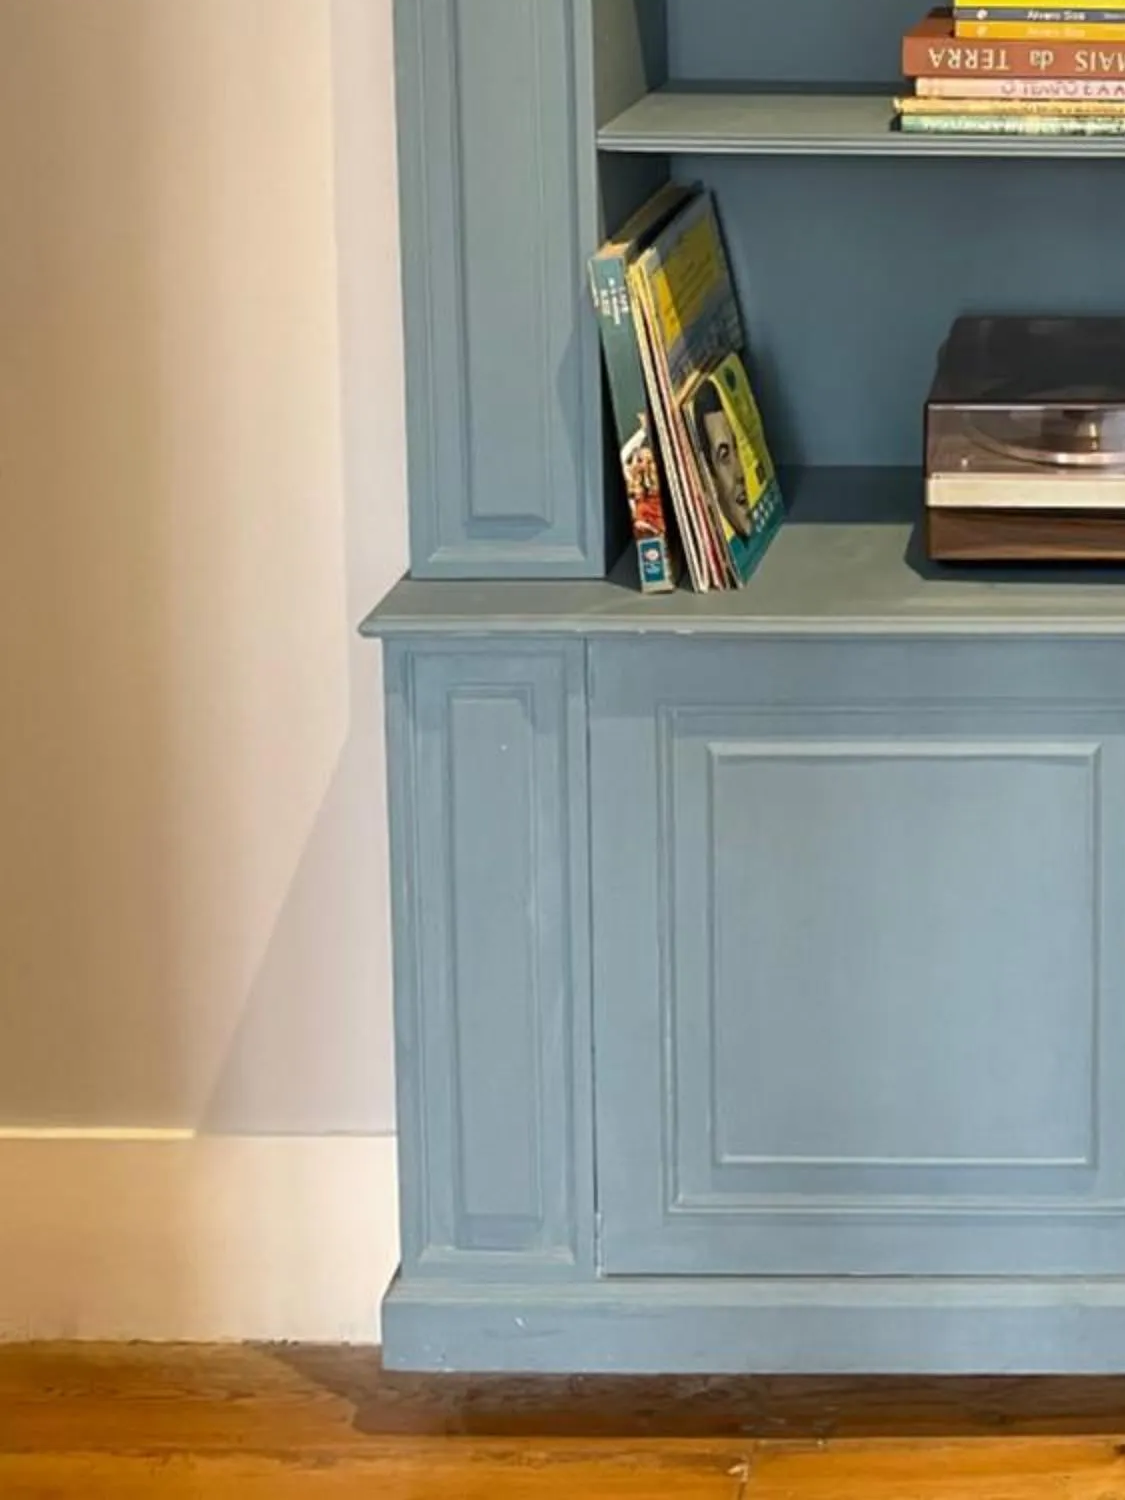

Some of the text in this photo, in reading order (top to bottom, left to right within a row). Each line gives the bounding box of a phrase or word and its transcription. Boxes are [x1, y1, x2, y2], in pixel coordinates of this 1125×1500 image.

[927, 47, 1010, 72] TERRA
[1028, 48, 1055, 71] da
[1097, 84, 1110, 96] A
